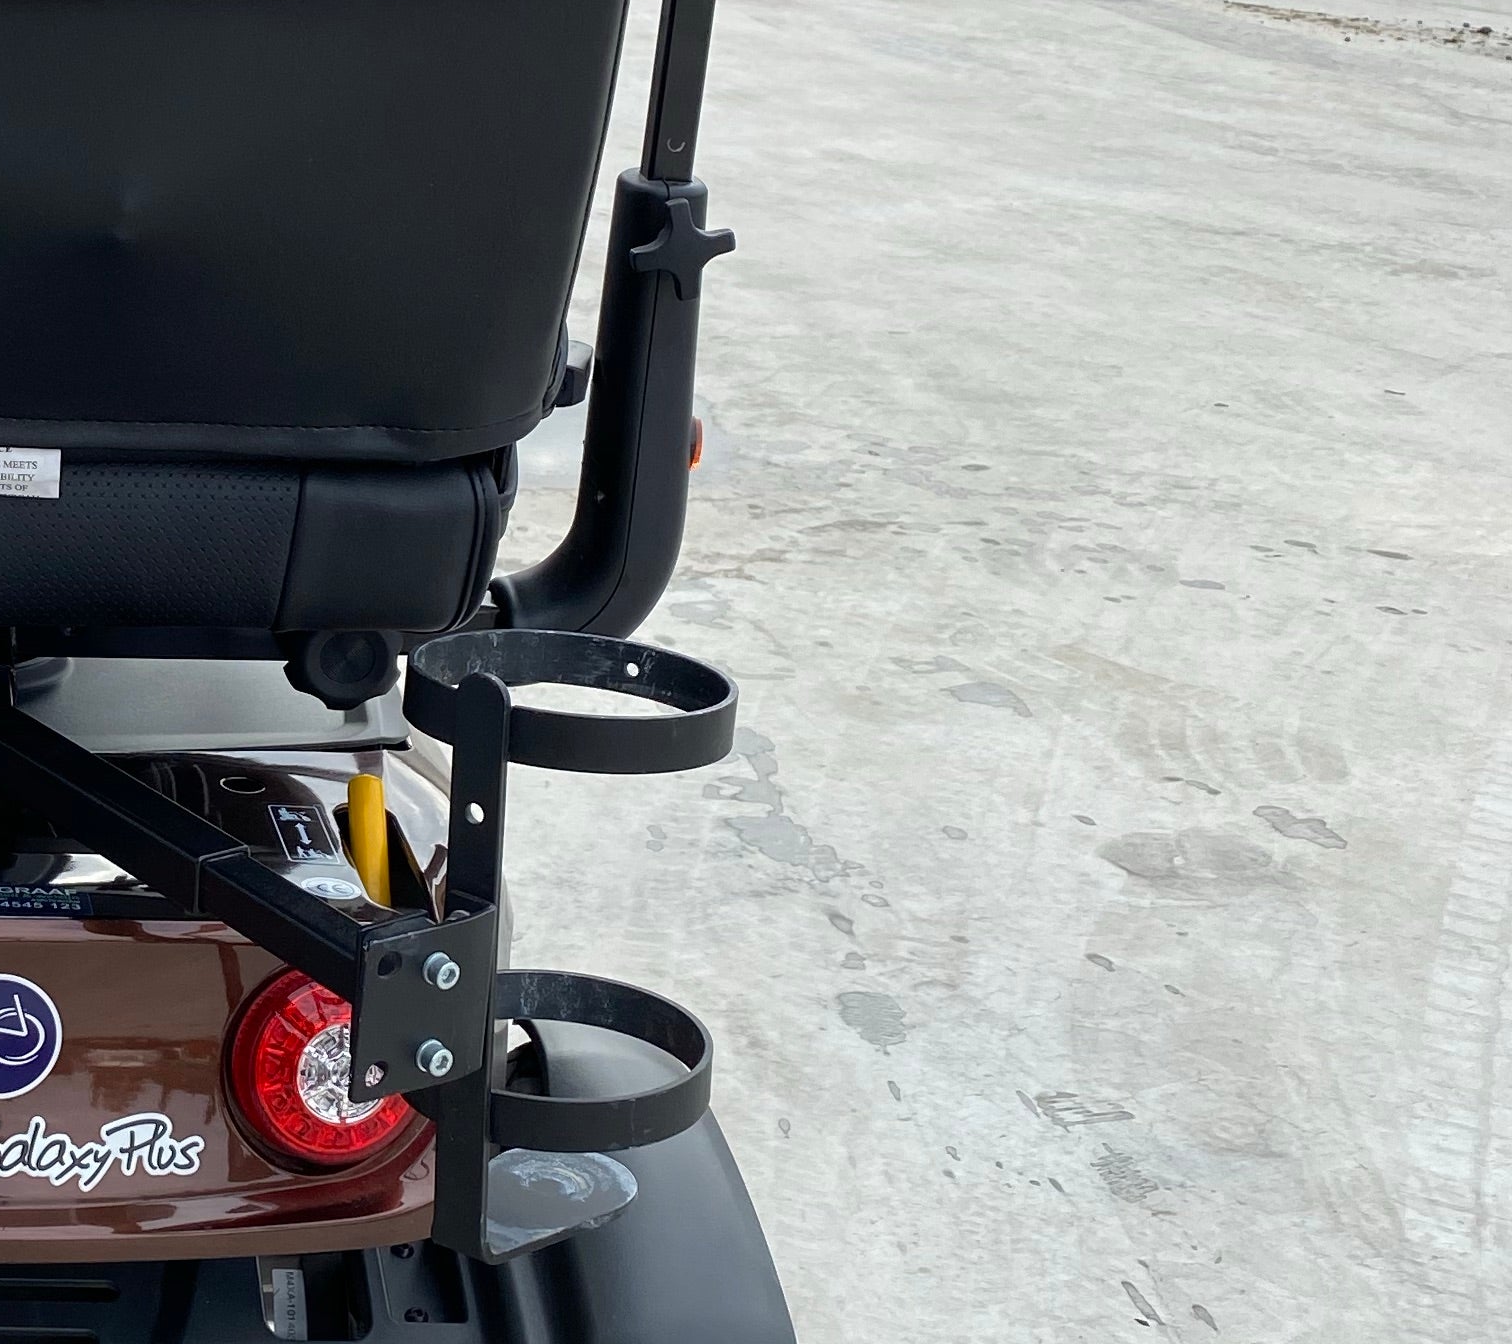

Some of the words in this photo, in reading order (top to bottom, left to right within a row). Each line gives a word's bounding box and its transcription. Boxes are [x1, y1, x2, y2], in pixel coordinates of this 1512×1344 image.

[3, 460, 38, 470] MEETS
[14, 483, 29, 492] OF
[104, 1115, 202, 1173] Plus
